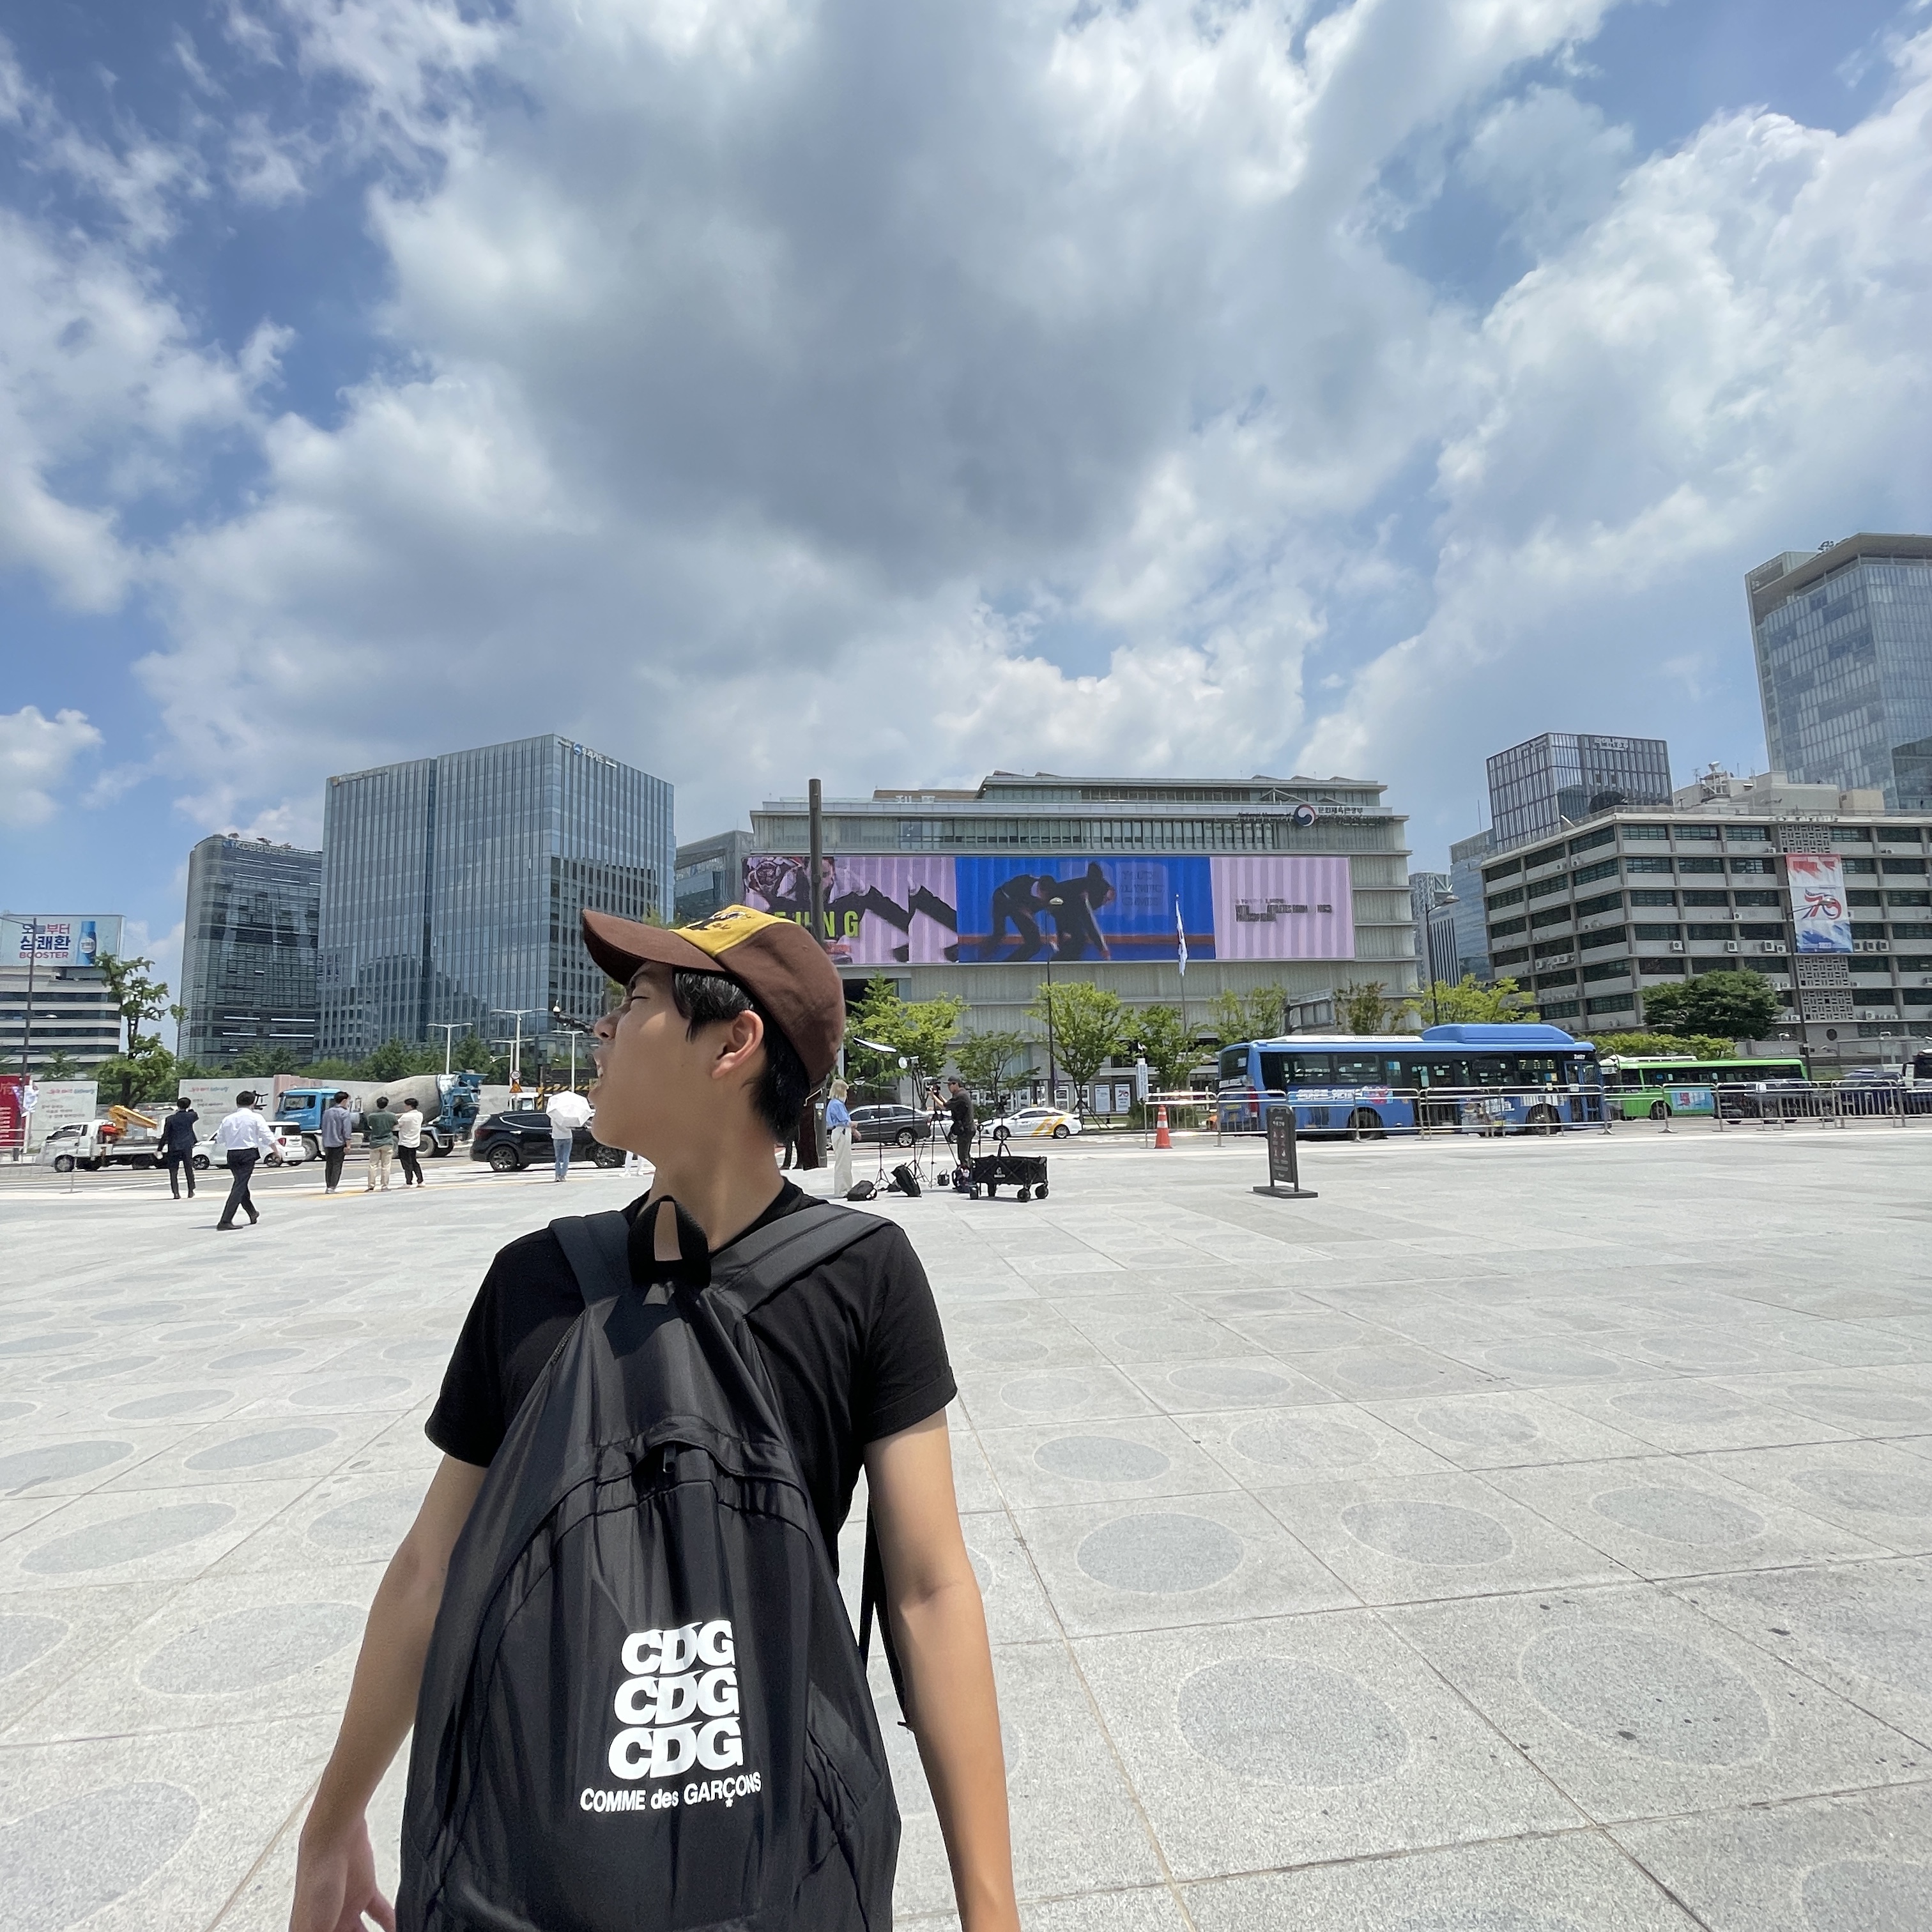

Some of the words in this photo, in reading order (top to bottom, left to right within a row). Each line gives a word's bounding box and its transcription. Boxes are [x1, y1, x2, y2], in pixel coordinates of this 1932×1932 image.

[622, 1620, 735, 1675] CDG
[614, 1667, 740, 1724] CDG
[608, 1717, 744, 1779] CDG
[580, 1788, 646, 1813] COMME
[650, 1789, 678, 1809] des
[684, 1772, 762, 1807] GARÇONS
